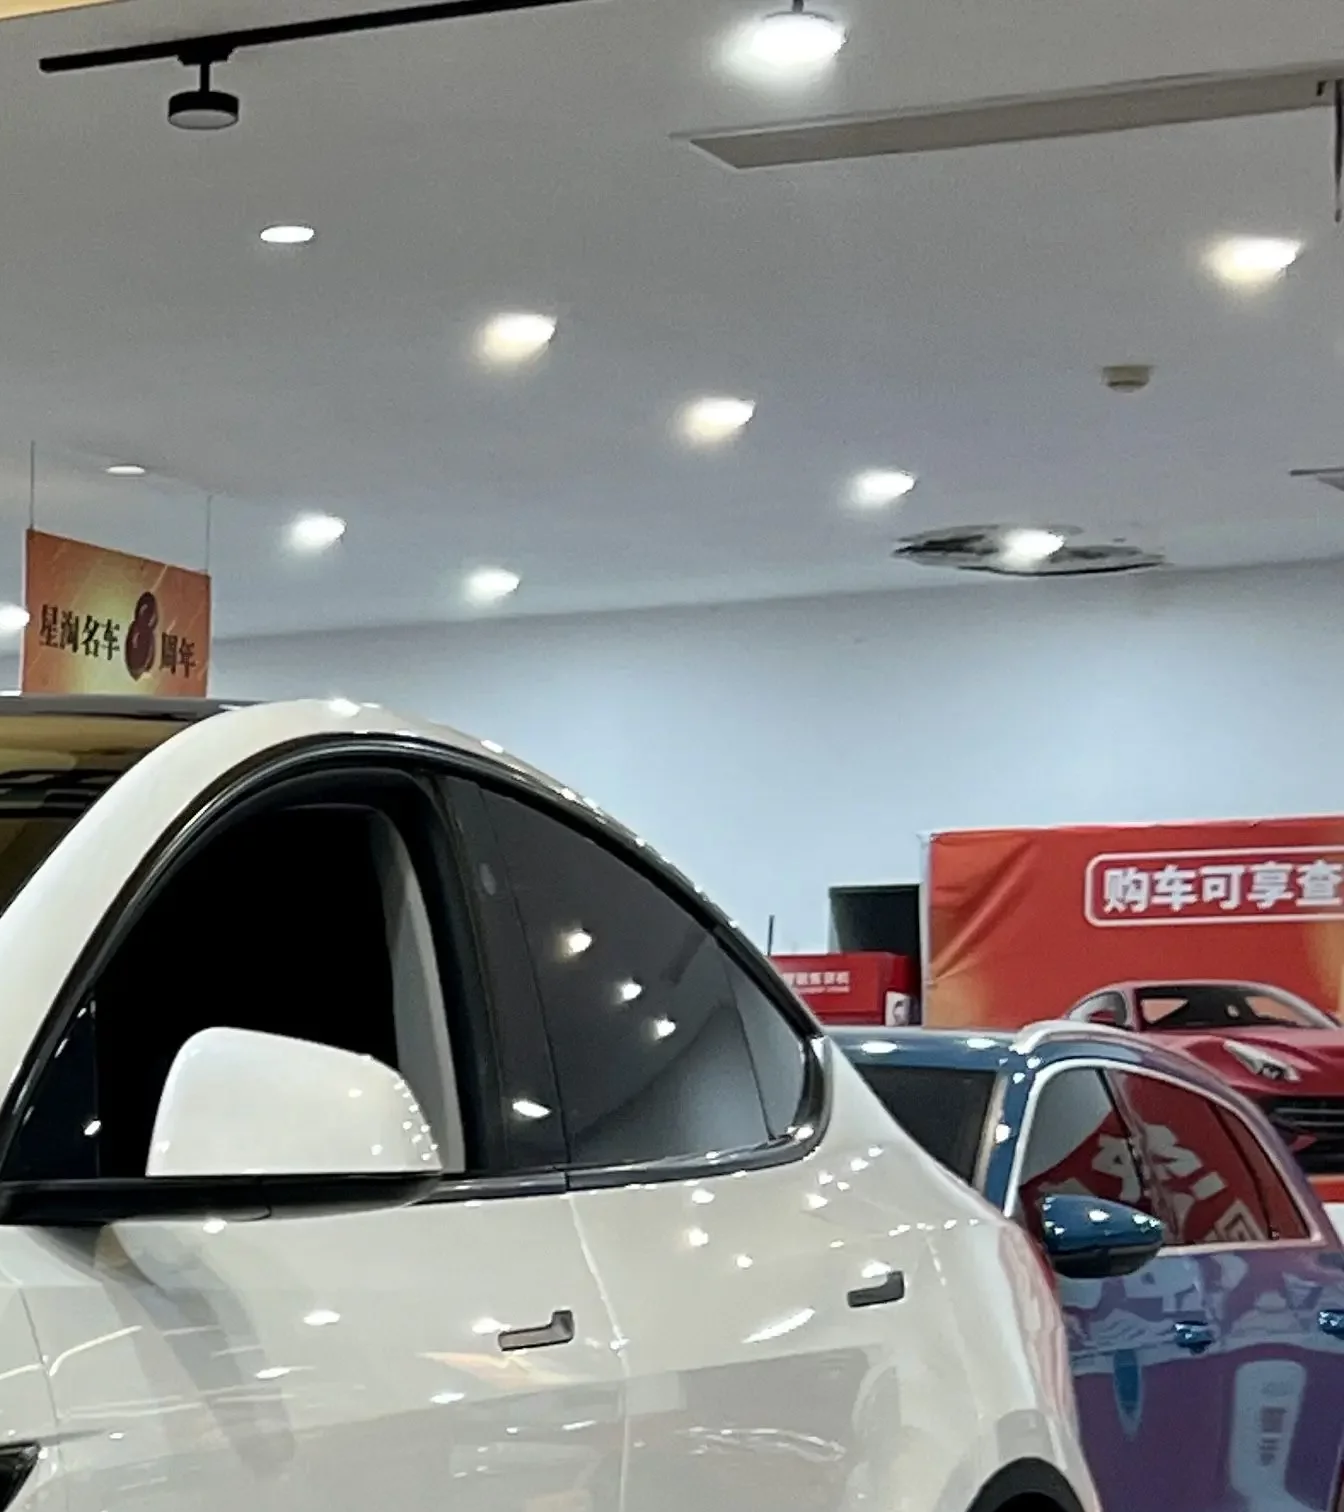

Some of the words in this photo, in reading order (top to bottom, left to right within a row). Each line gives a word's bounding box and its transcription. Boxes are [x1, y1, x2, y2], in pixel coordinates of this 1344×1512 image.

[1102, 859, 1343, 914] 购车可享查
